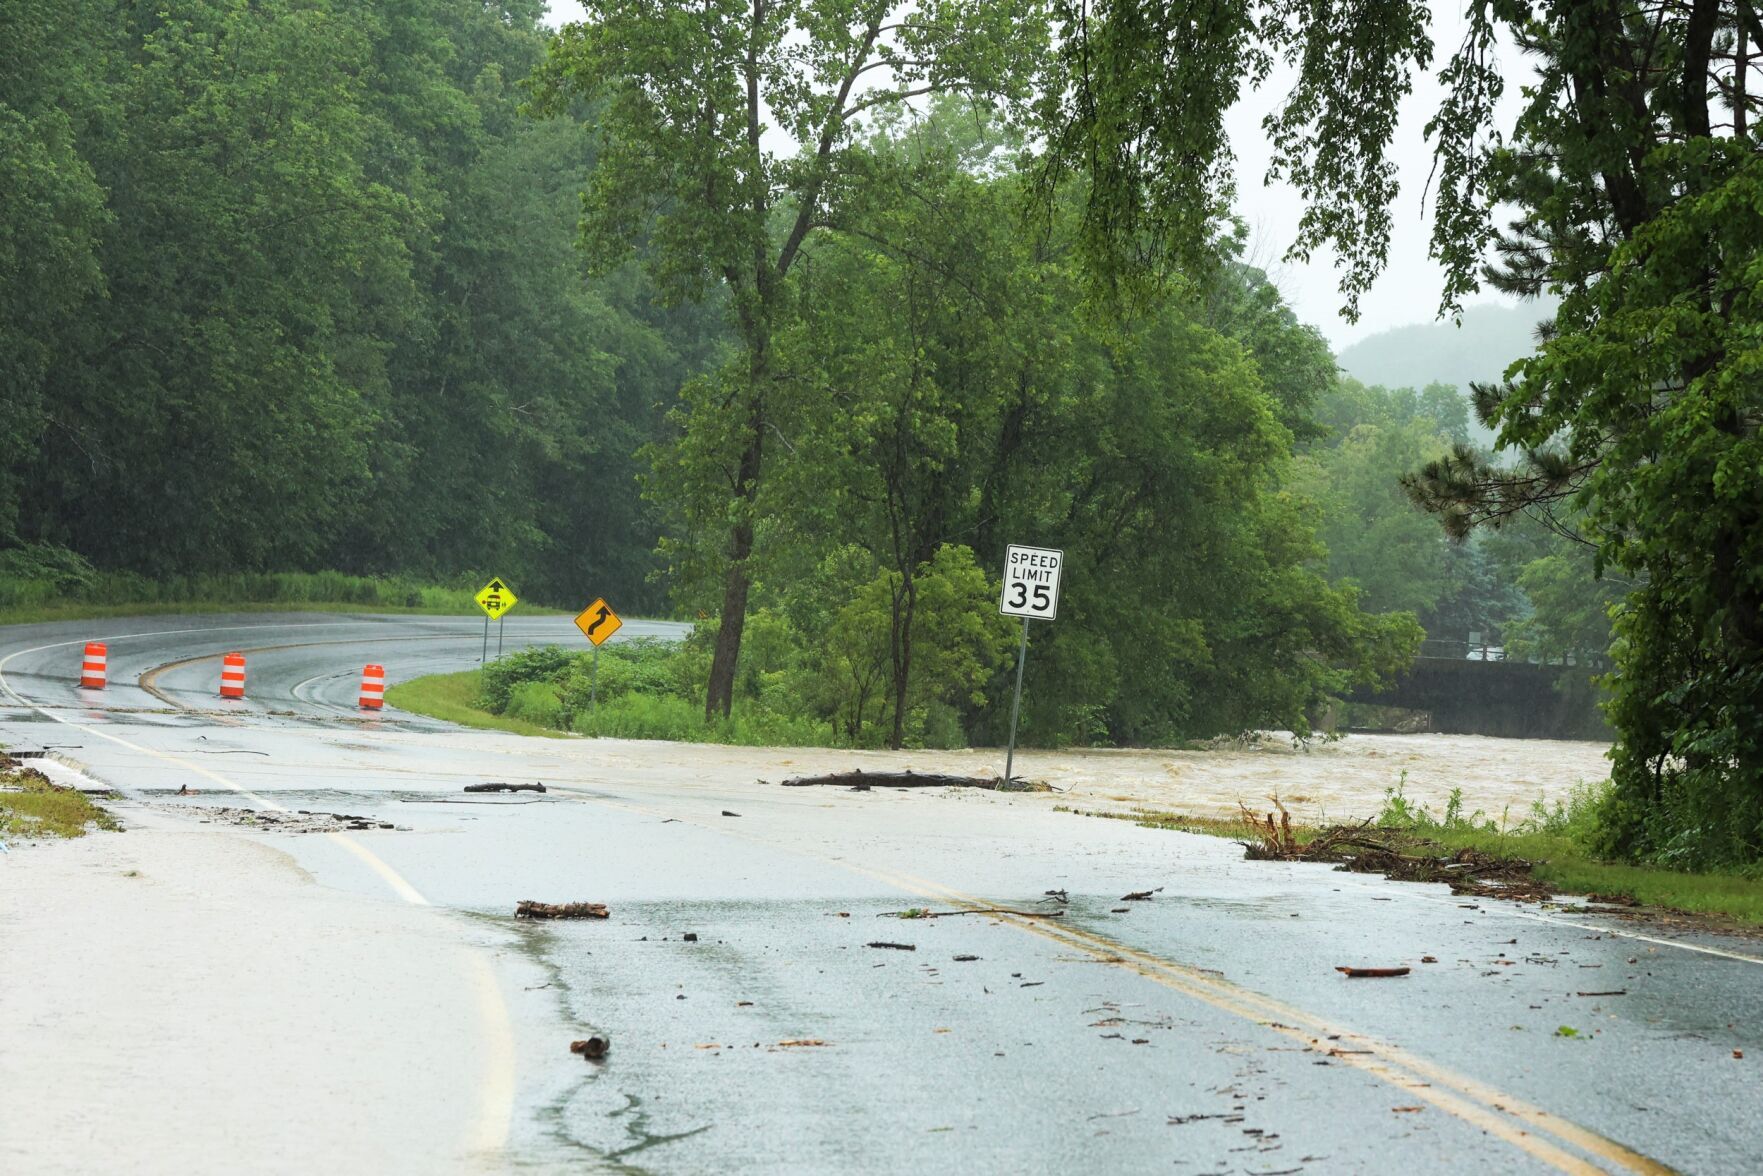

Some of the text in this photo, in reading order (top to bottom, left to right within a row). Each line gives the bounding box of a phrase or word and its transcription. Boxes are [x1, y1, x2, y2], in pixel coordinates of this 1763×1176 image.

[1010, 552, 1058, 569] SPEED
[1012, 567, 1052, 583] LIMIT
[1008, 582, 1051, 611] 35
